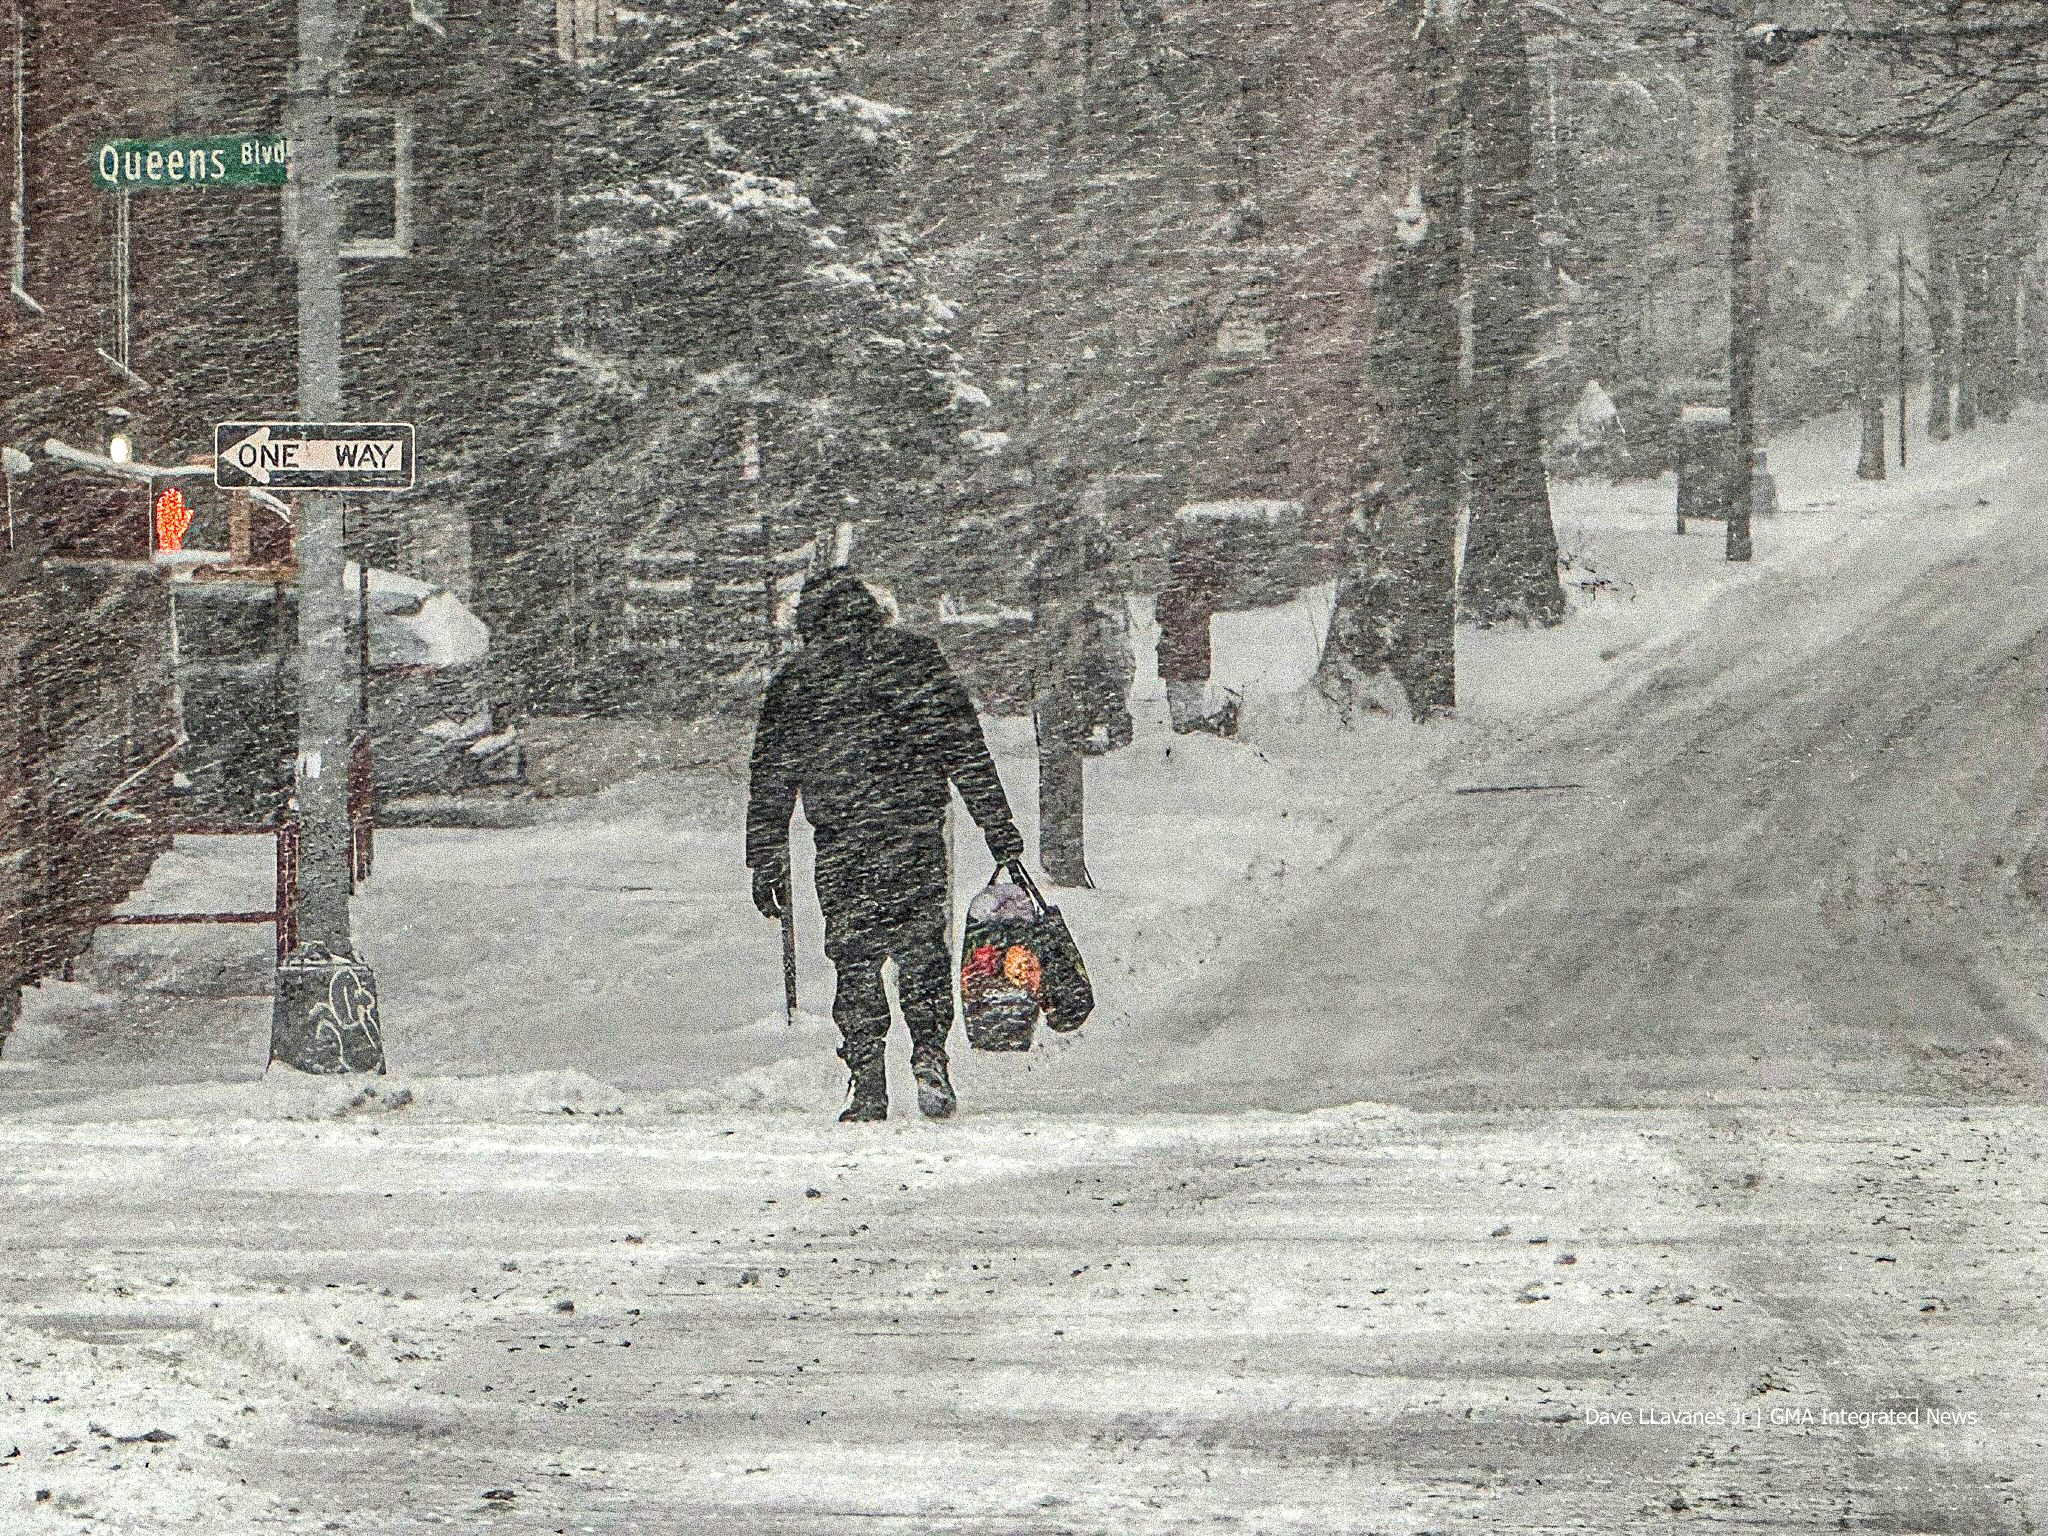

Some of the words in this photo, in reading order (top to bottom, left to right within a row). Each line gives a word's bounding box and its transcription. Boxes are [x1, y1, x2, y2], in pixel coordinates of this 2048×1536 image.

[100, 144, 226, 184] Queens
[241, 139, 285, 165] Blvd
[238, 443, 300, 469] ONE
[335, 443, 395, 469] WAY
